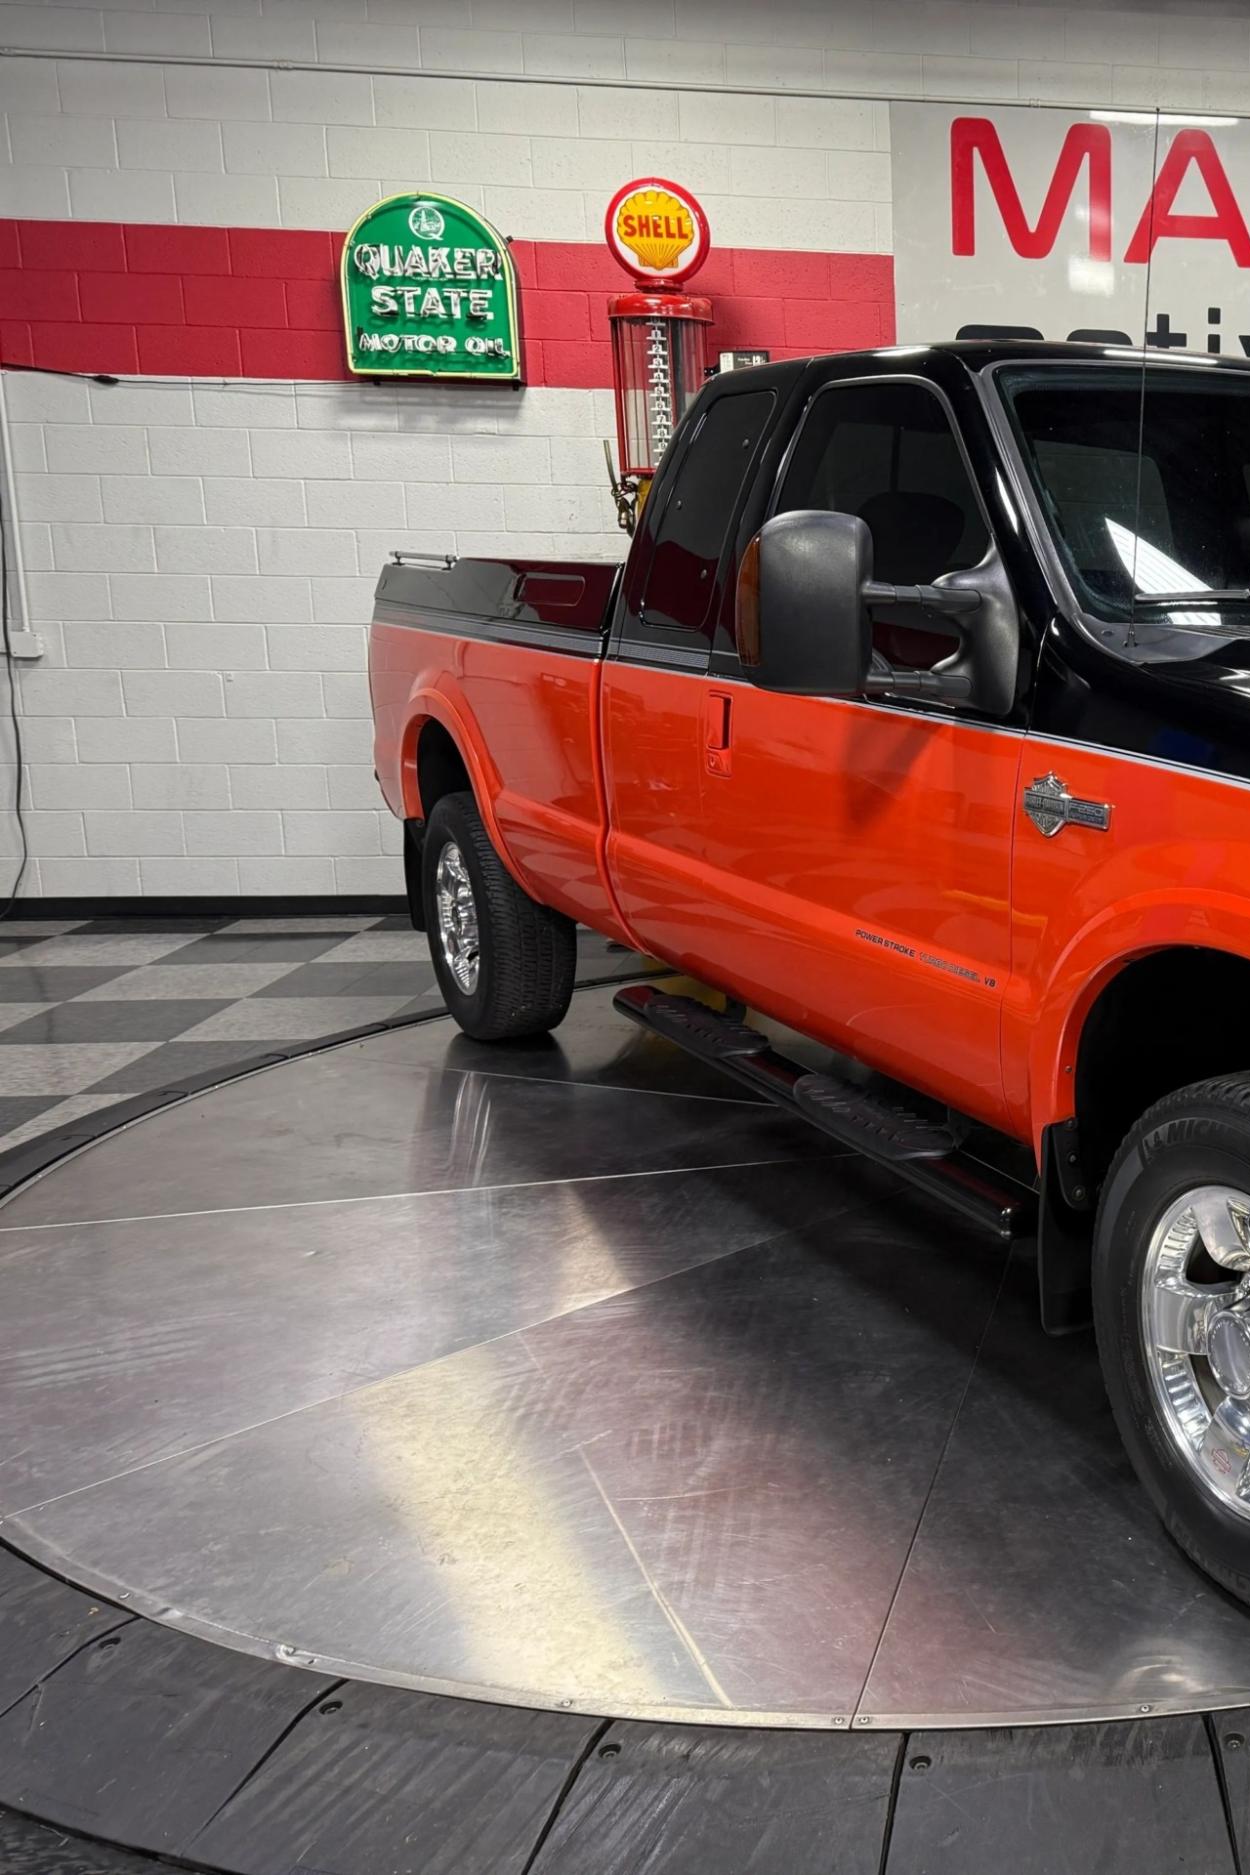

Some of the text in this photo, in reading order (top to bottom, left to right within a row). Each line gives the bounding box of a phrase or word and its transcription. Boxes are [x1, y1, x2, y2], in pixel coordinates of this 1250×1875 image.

[622, 213, 689, 240] SHELL
[353, 243, 502, 280] QUAKER
[371, 285, 494, 320] STATE
[359, 332, 511, 358] MOTOR OIL
[855, 929, 884, 946] POWER
[884, 941, 915, 957] STROKE
